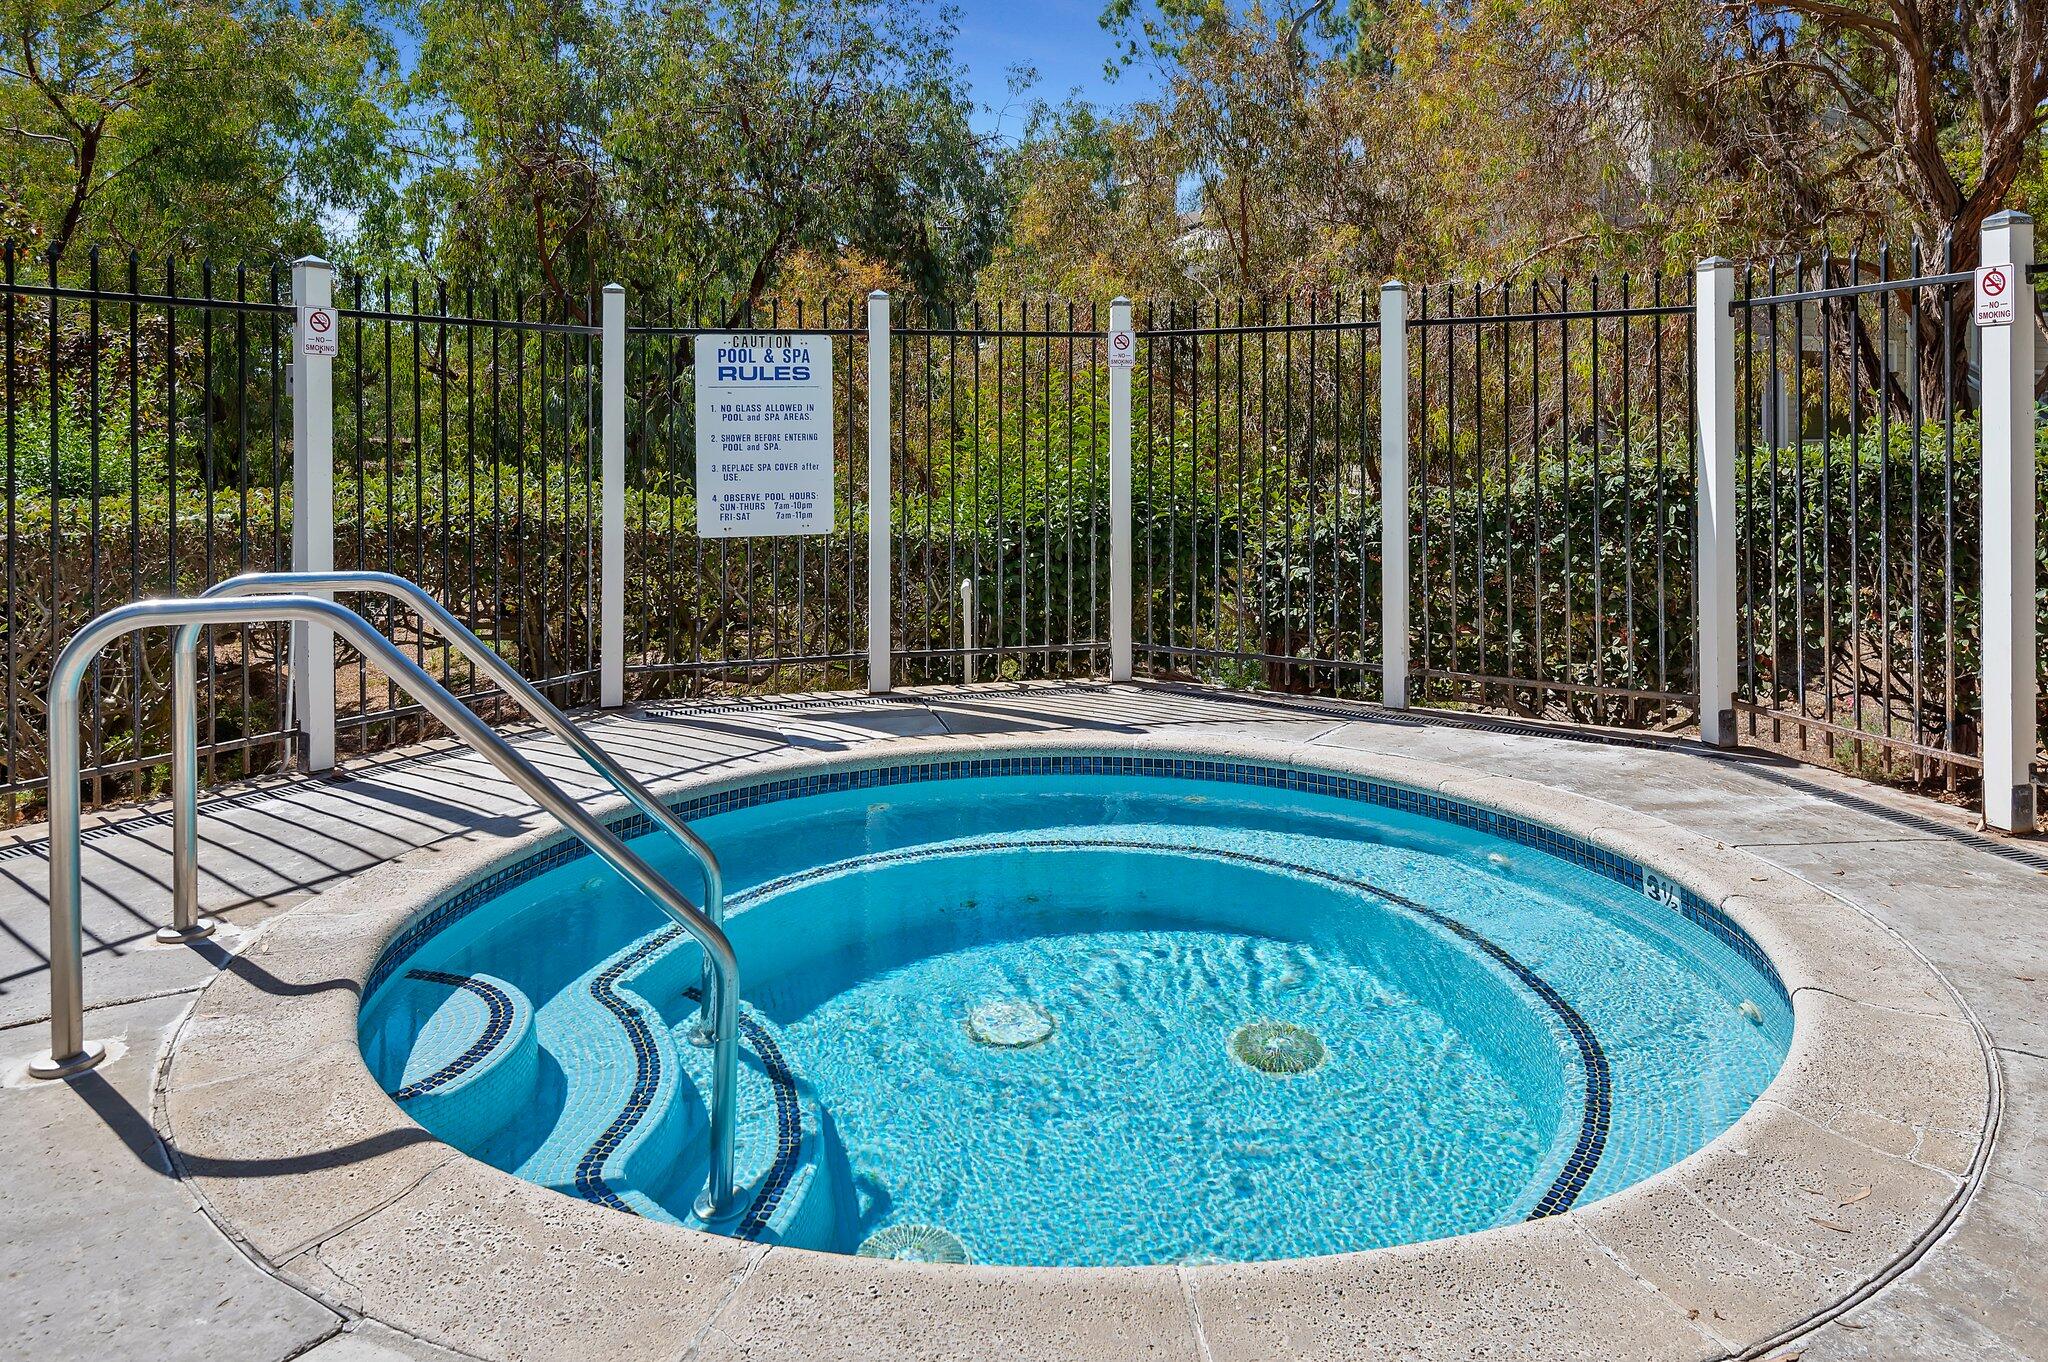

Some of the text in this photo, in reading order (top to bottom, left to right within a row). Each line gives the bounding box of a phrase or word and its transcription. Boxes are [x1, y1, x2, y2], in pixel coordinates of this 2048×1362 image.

[1989, 301, 2000, 309] NO
[1978, 310, 2011, 320] SMOKING
[732, 336, 792, 348] CAUTION
[305, 344, 335, 352] SMOKING
[717, 348, 810, 363] POOL & SPA
[718, 366, 811, 381] RULES
[720, 404, 732, 412] NO
[735, 404, 762, 412] GLASS
[765, 404, 803, 412] ALLOWED
[806, 403, 815, 412] IN
[722, 412, 812, 421] POOL and SPA AREAS.
[710, 433, 818, 443] 2. SHOWER BEFORE ENTERING
[722, 443, 781, 451] POOL and SPA.
[711, 463, 820, 472] 3. REPLACE SPA COVER after
[723, 473, 741, 481] USE.
[723, 493, 761, 502] OBSERVE
[764, 492, 786, 501] POOL
[719, 502, 813, 511] SUN-THURS 7am-10pm
[719, 511, 813, 521] FRI-SAT 7am-11pm
